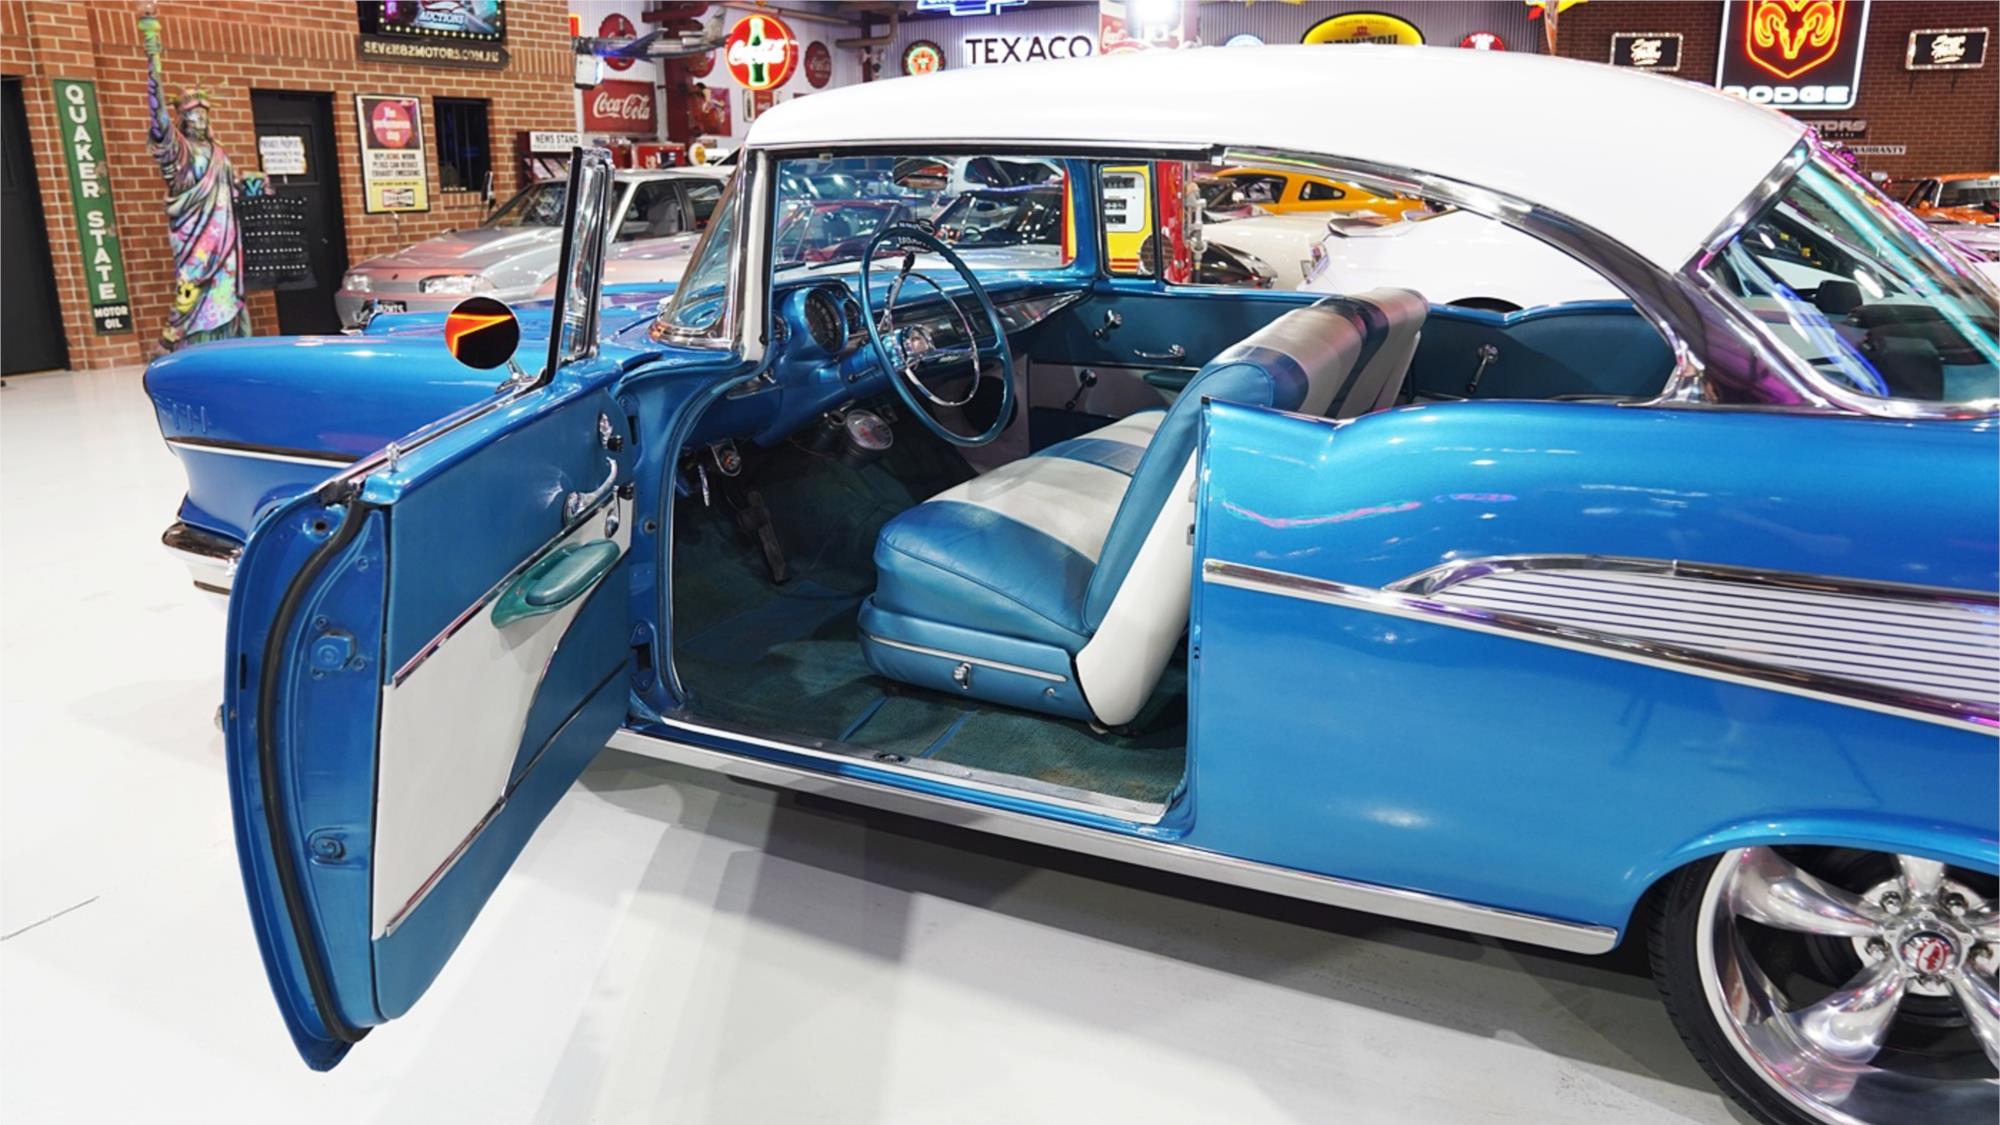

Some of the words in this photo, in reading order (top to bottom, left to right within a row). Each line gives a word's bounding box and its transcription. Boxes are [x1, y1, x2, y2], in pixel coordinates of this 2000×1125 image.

[964, 35, 1093, 65] TEXACO
[1722, 85, 1850, 104] DODGE
[535, 134, 554, 145] NEWS
[556, 133, 579, 145] STAND
[65, 84, 101, 198] QUAKER
[87, 210, 118, 301] STATE
[93, 305, 129, 319] MOTOR
[104, 318, 123, 330] OIL
